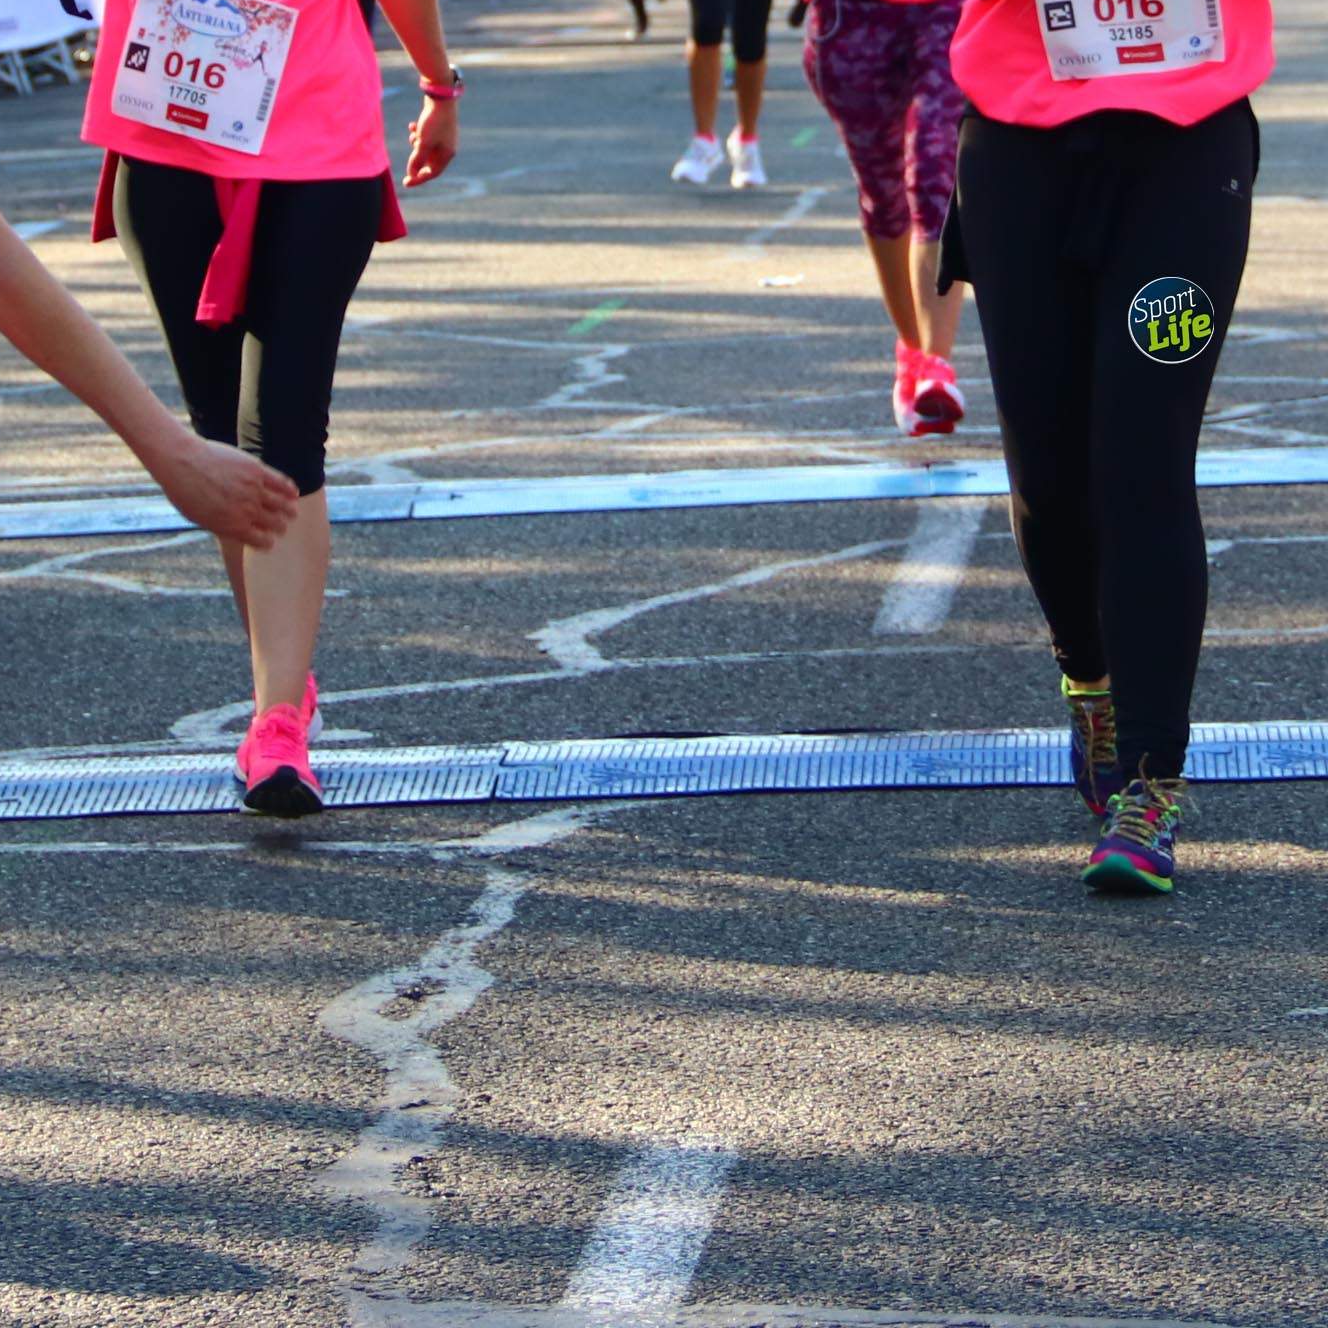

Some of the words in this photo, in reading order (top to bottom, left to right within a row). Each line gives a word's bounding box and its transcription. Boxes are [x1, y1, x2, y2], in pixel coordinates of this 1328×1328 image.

[1109, 25, 1154, 42] 32185
[163, 50, 227, 89] 016
[169, 85, 207, 106] 17705
